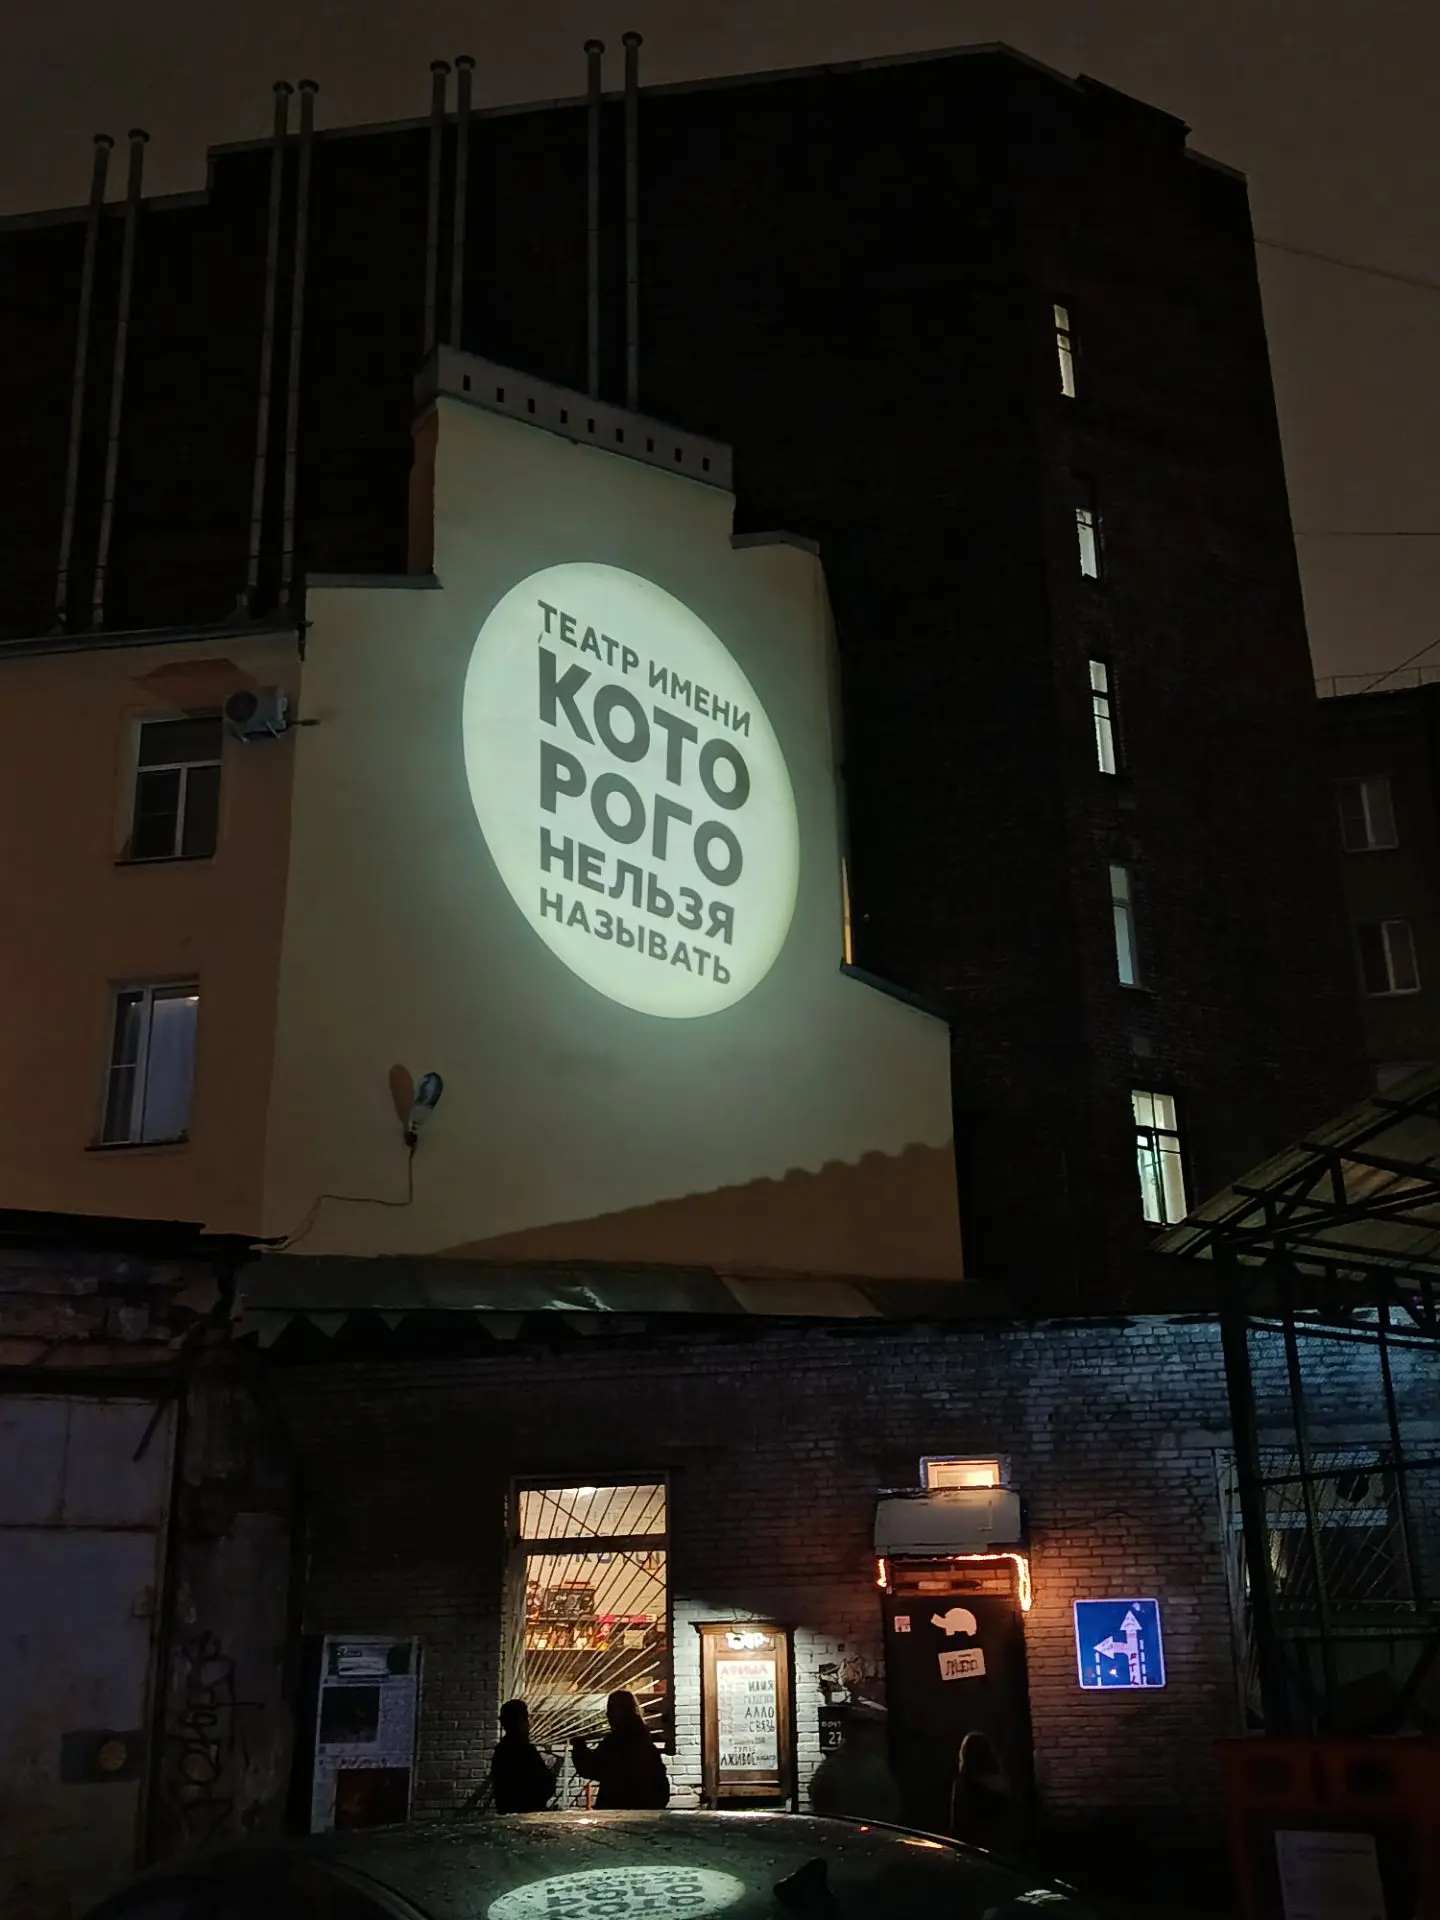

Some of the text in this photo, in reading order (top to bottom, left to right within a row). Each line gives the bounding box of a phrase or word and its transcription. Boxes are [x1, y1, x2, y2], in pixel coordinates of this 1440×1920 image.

[537, 600, 752, 737] ТЕАТР ИМЕНИ
[538, 646, 751, 811] КОТО
[539, 739, 744, 887] РОГО
[539, 827, 735, 945] НЕЛЬЗЯ
[539, 887, 732, 985] НАЗЫВАТЬ
